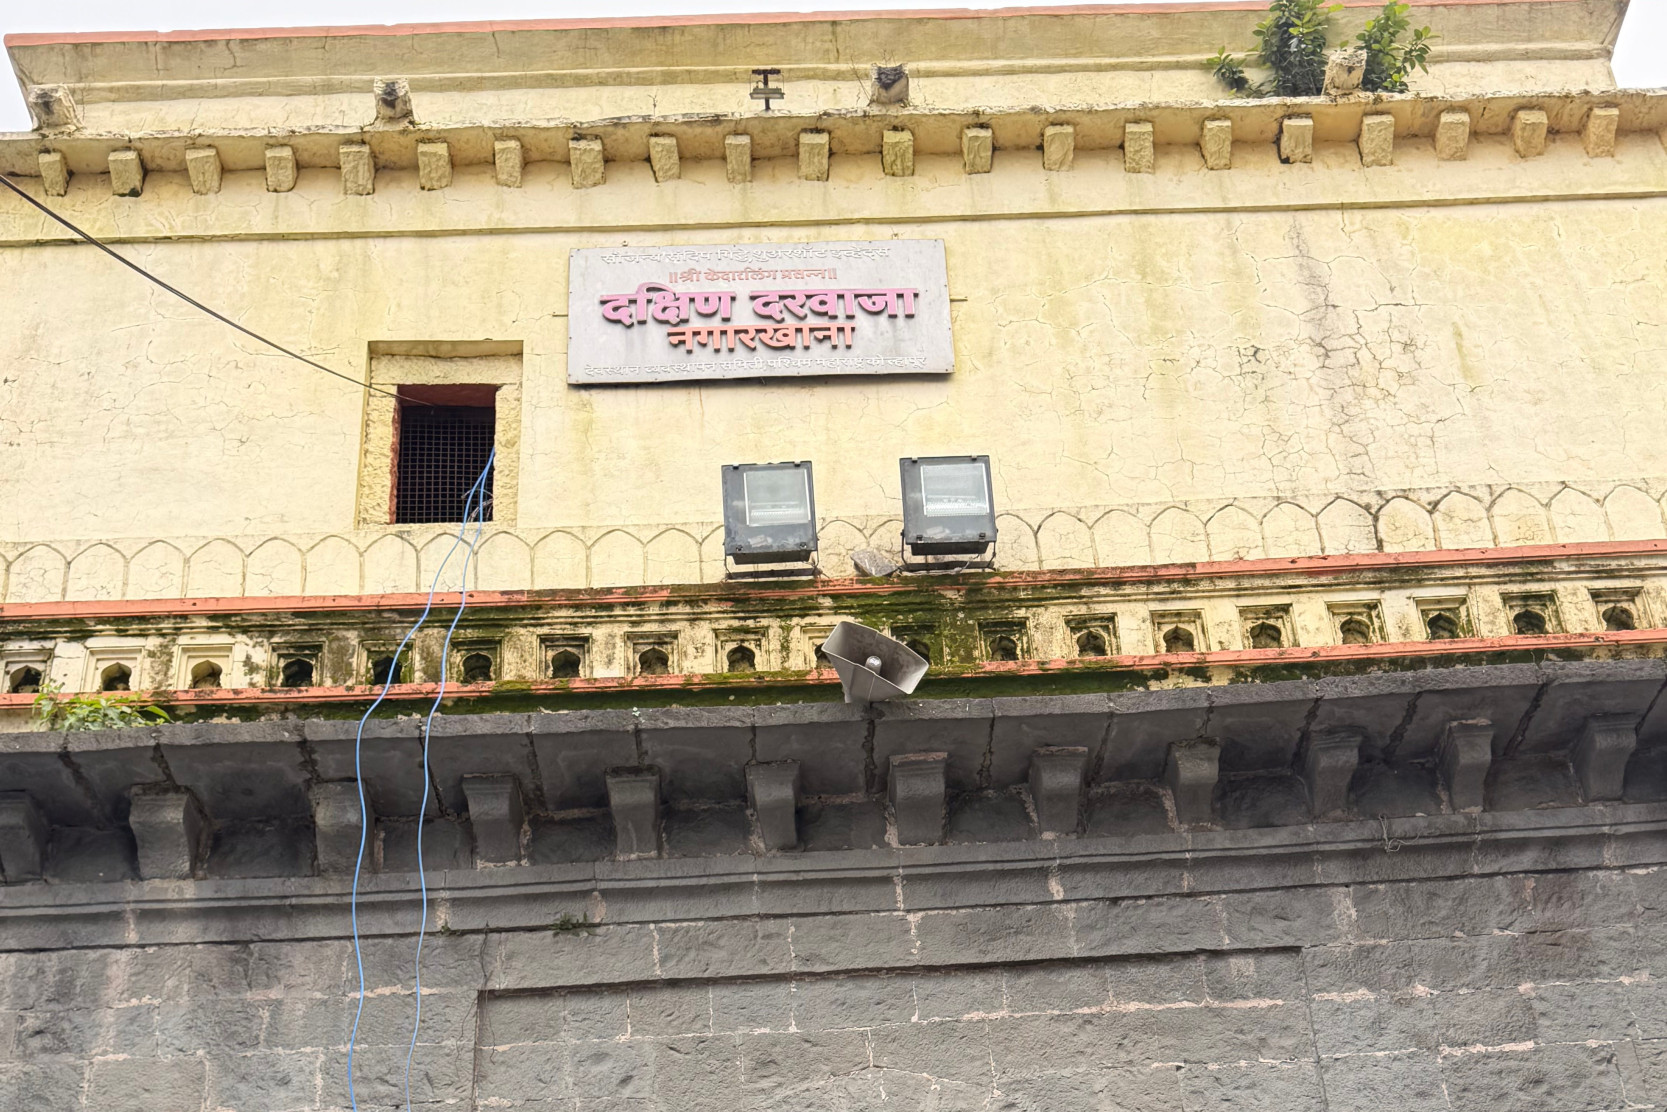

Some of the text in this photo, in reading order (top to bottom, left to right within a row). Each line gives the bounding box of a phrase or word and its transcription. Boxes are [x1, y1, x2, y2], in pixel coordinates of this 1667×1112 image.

[703, 267, 778, 283] केदारलिंग
[600, 282, 919, 327] दक्षिण दरवाजा
[667, 323, 856, 354] नगारखाना
[584, 364, 641, 377] देवस्थान
[644, 361, 718, 375] व्यवस्थापन
